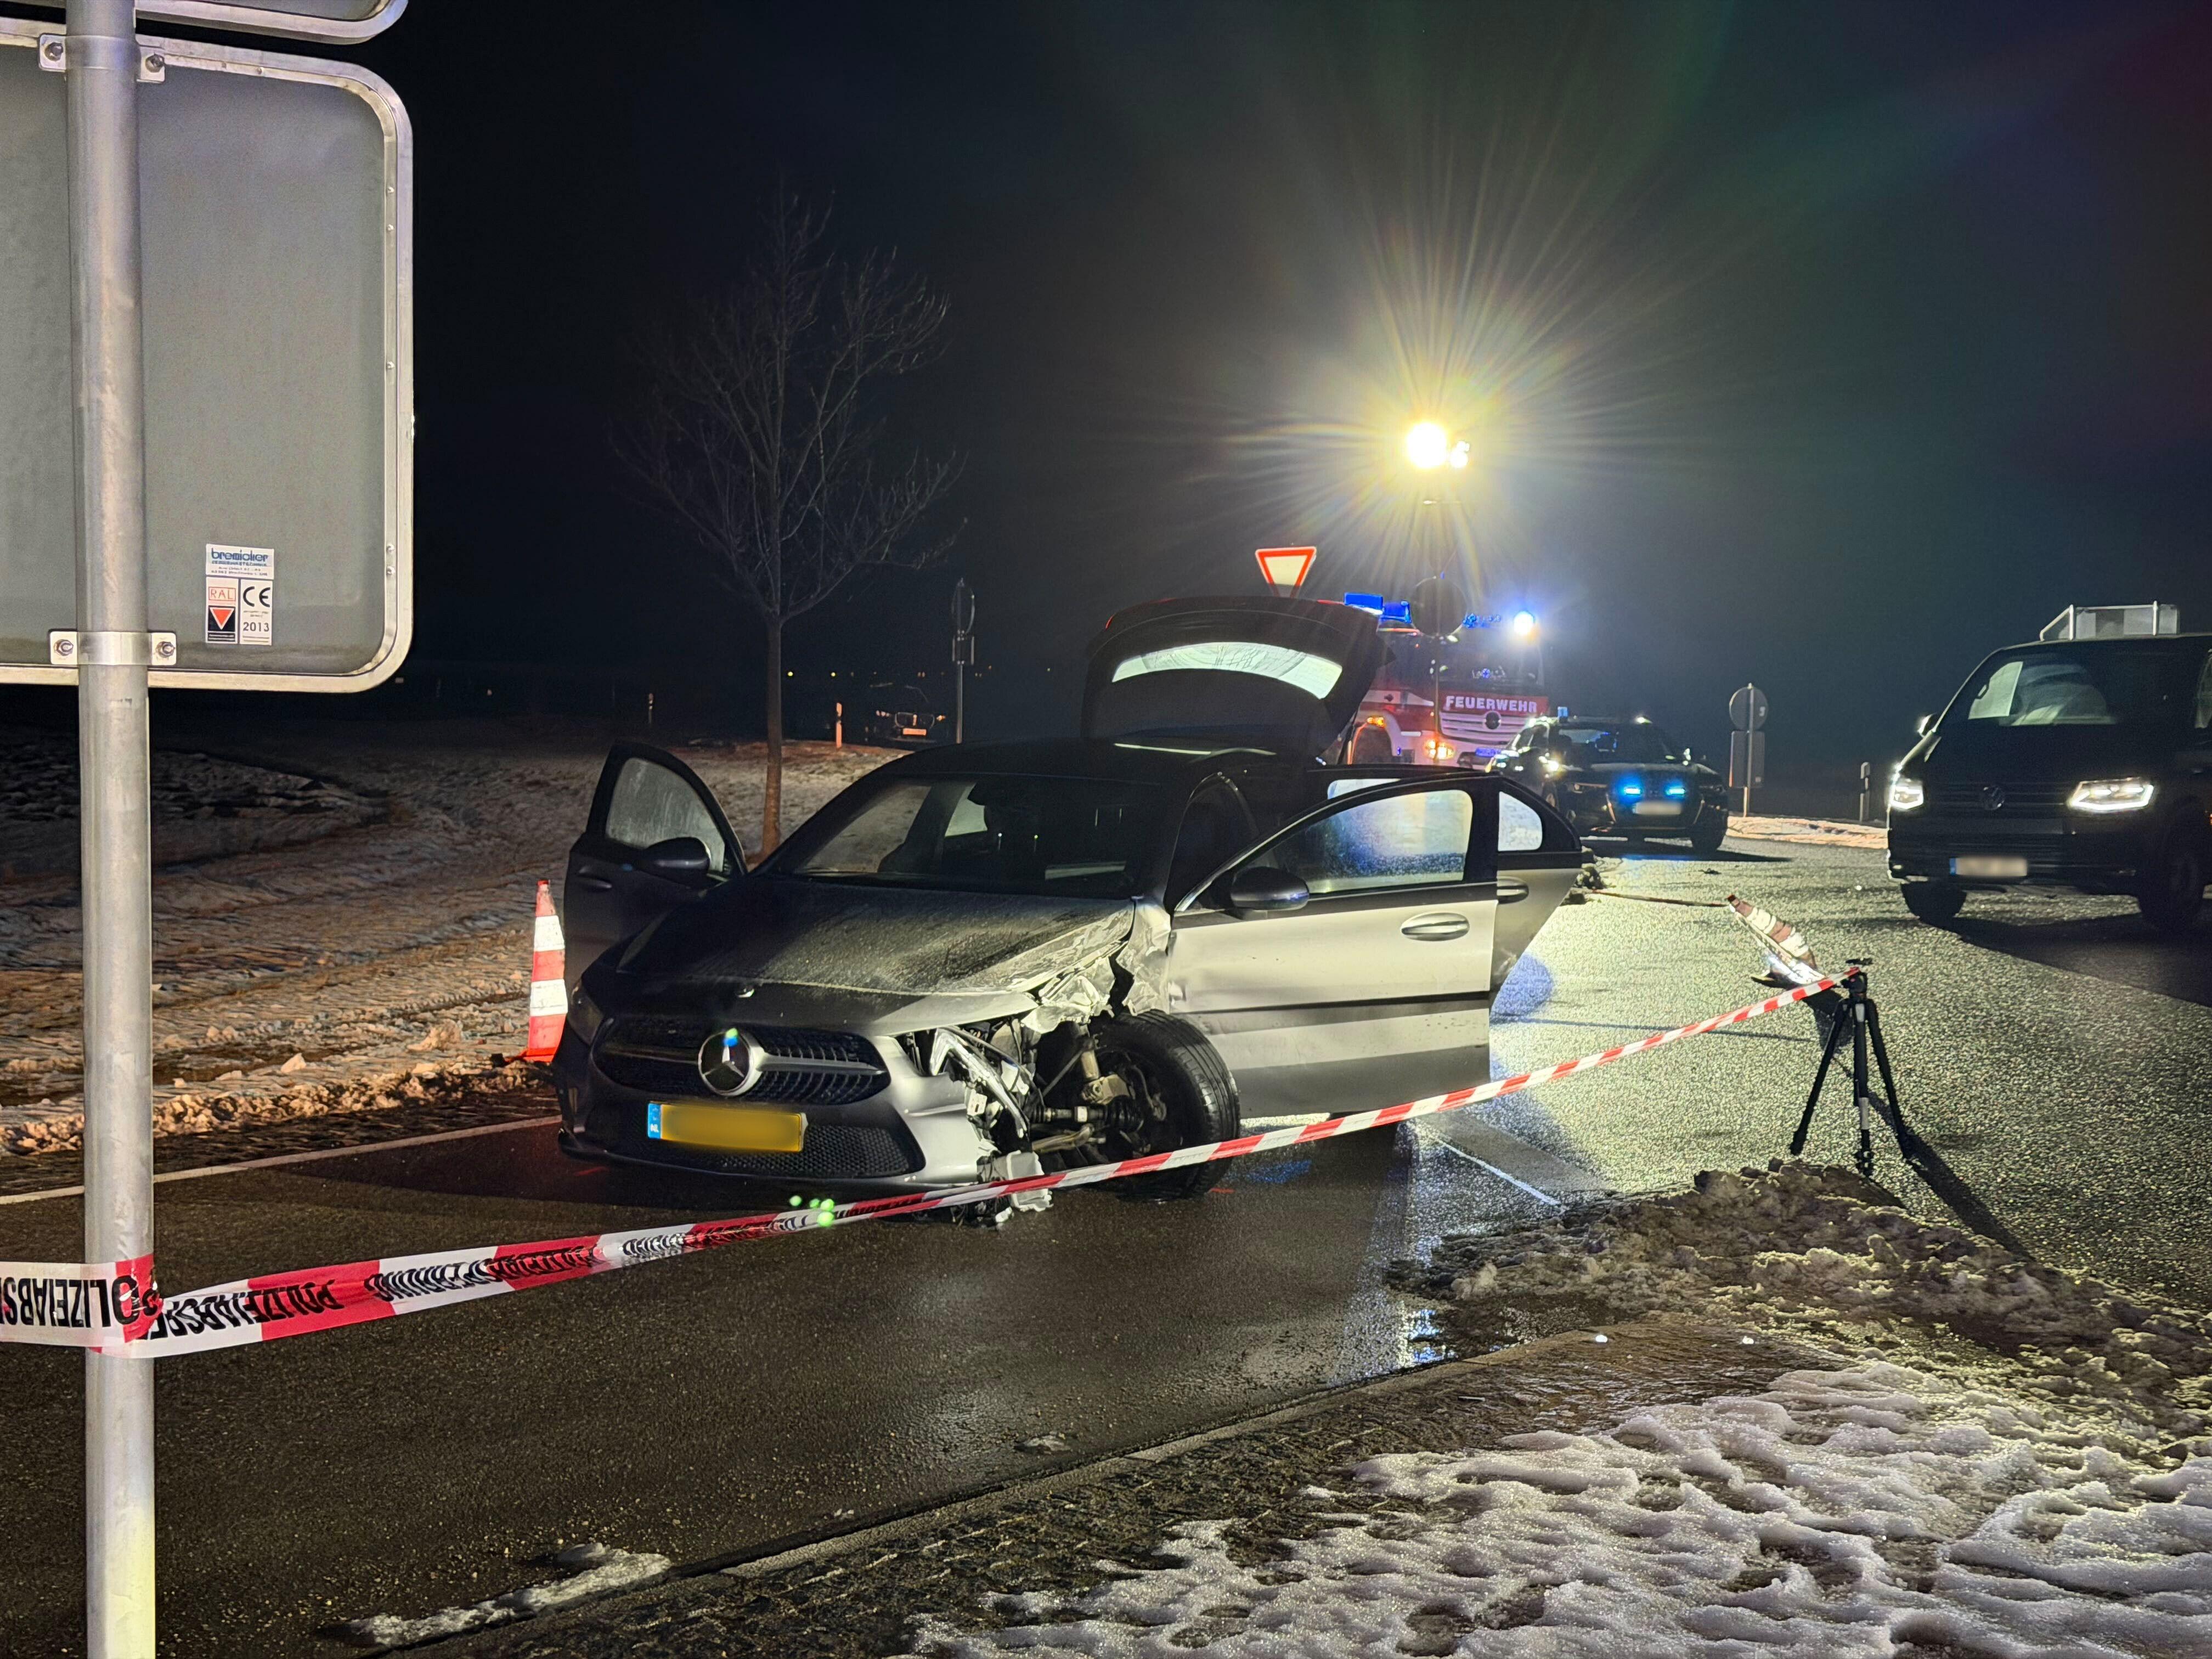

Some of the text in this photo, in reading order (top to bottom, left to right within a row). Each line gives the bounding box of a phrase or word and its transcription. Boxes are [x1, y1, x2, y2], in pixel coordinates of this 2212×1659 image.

[210, 589, 233, 600] RAL
[243, 586, 270, 607] CE
[243, 622, 269, 632] 2013
[1446, 695, 1537, 713] FEUERWEHR
